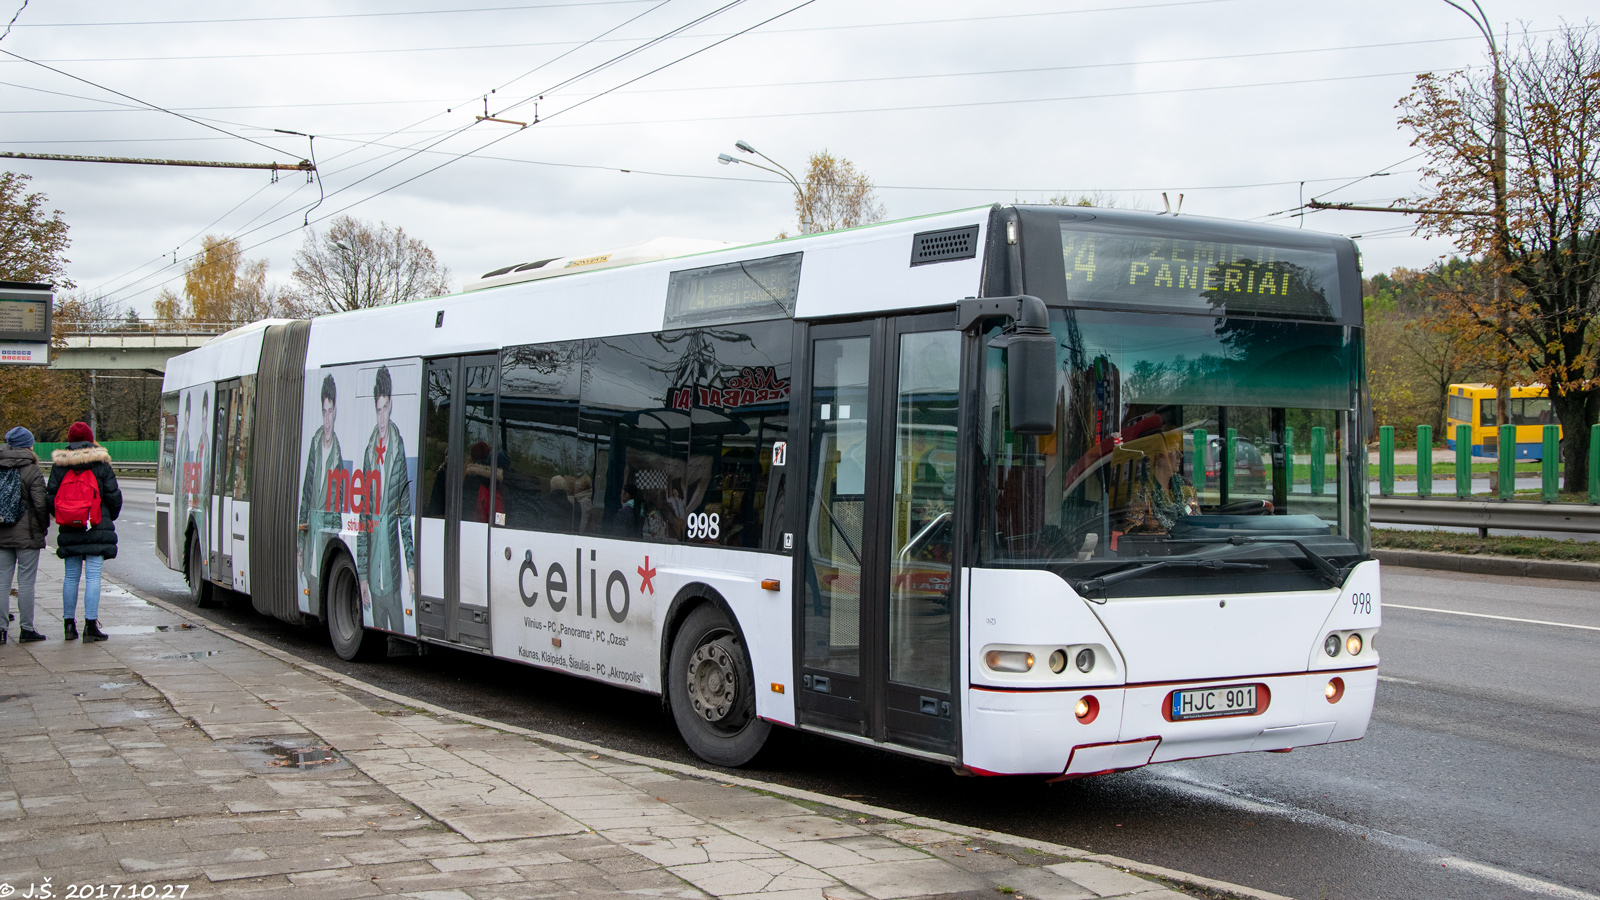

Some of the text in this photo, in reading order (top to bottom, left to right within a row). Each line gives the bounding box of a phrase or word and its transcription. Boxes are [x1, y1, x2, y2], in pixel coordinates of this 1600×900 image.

[1129, 262, 1289, 296] PANERIAI
[690, 281, 705, 310] 24
[687, 512, 720, 539] 998
[1352, 592, 1371, 614] 998
[524, 617, 542, 630] Vilnius
[547, 621, 557, 632] PC
[596, 630, 606, 642] PC
[518, 646, 540, 662] Kaunas,
[541, 651, 567, 668] Klaipėda,
[569, 654, 591, 672] Šiauliai
[596, 663, 606, 675] PC
[1183, 689, 1252, 712] HJC 901
